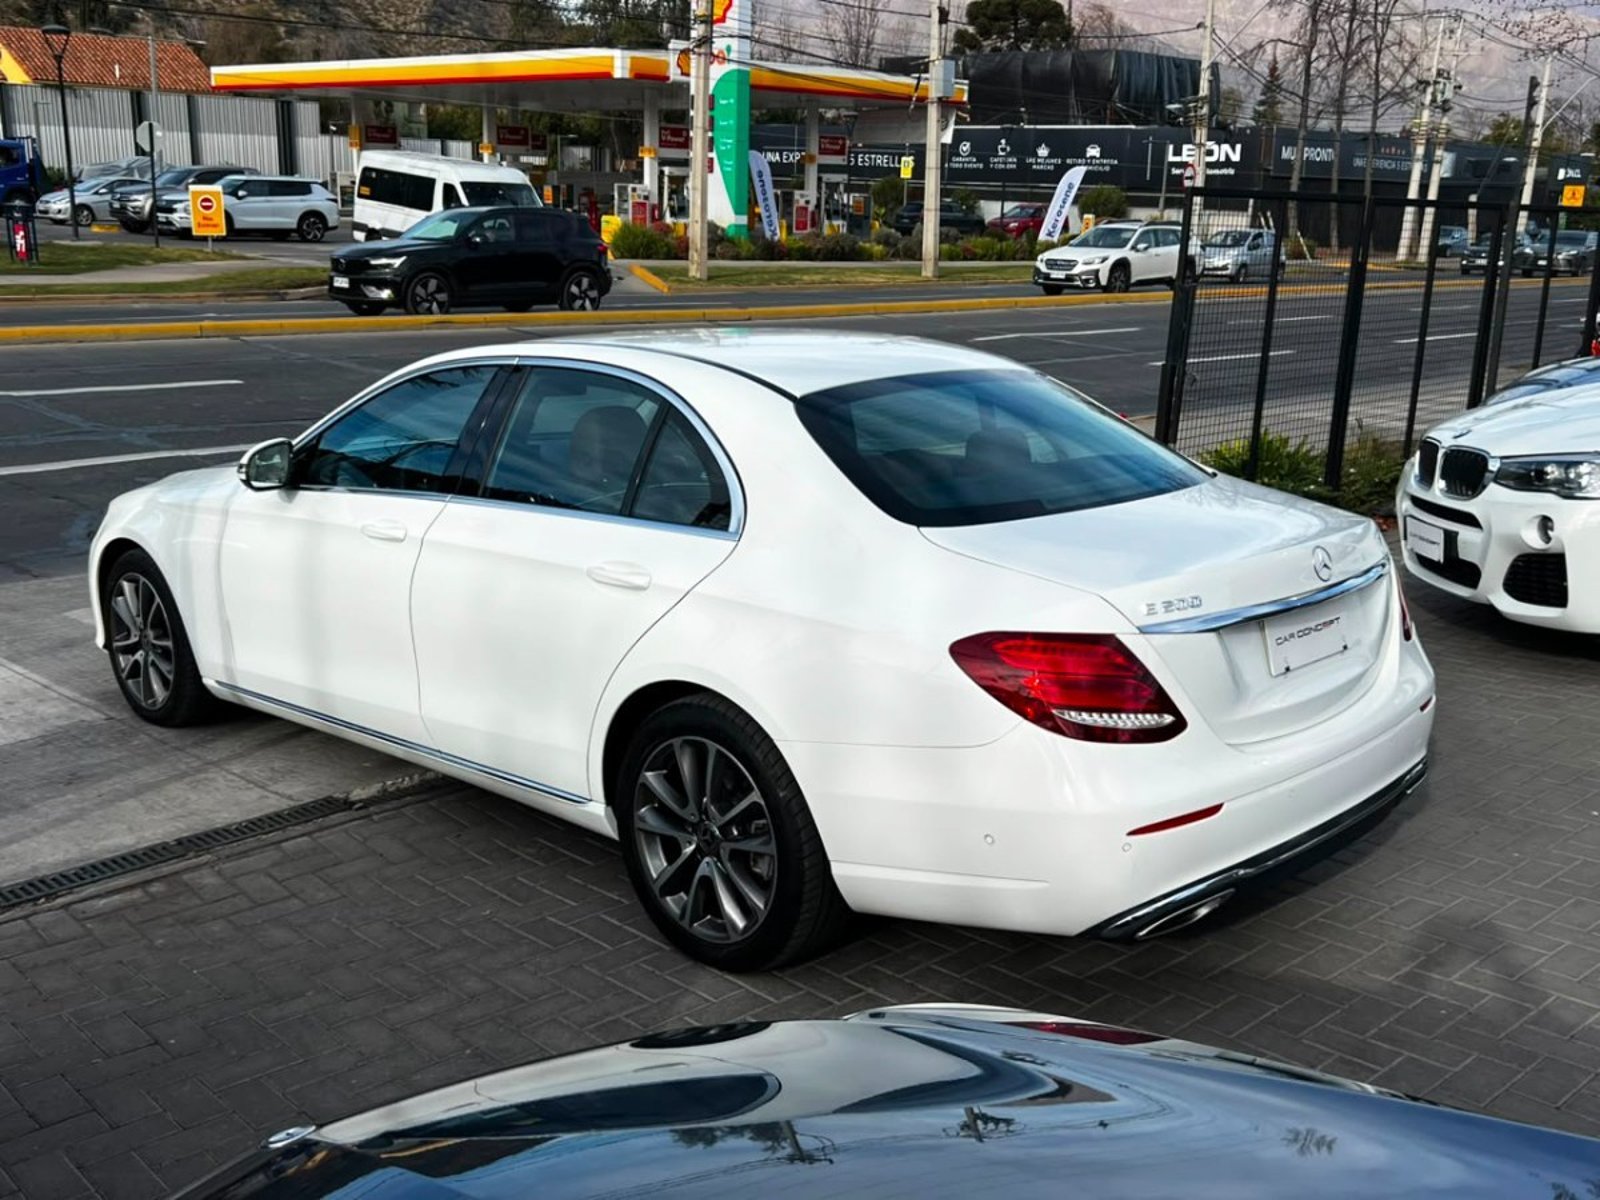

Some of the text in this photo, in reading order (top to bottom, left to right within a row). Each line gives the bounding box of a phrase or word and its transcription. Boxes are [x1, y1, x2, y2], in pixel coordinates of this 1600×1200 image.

[857, 154, 915, 168] ESTRELLS
[1281, 146, 1297, 160] MU
[1046, 182, 1075, 238] Kerosene
[1145, 595, 1202, 616] E 200
[1275, 616, 1341, 647] CAR CONCEPT
